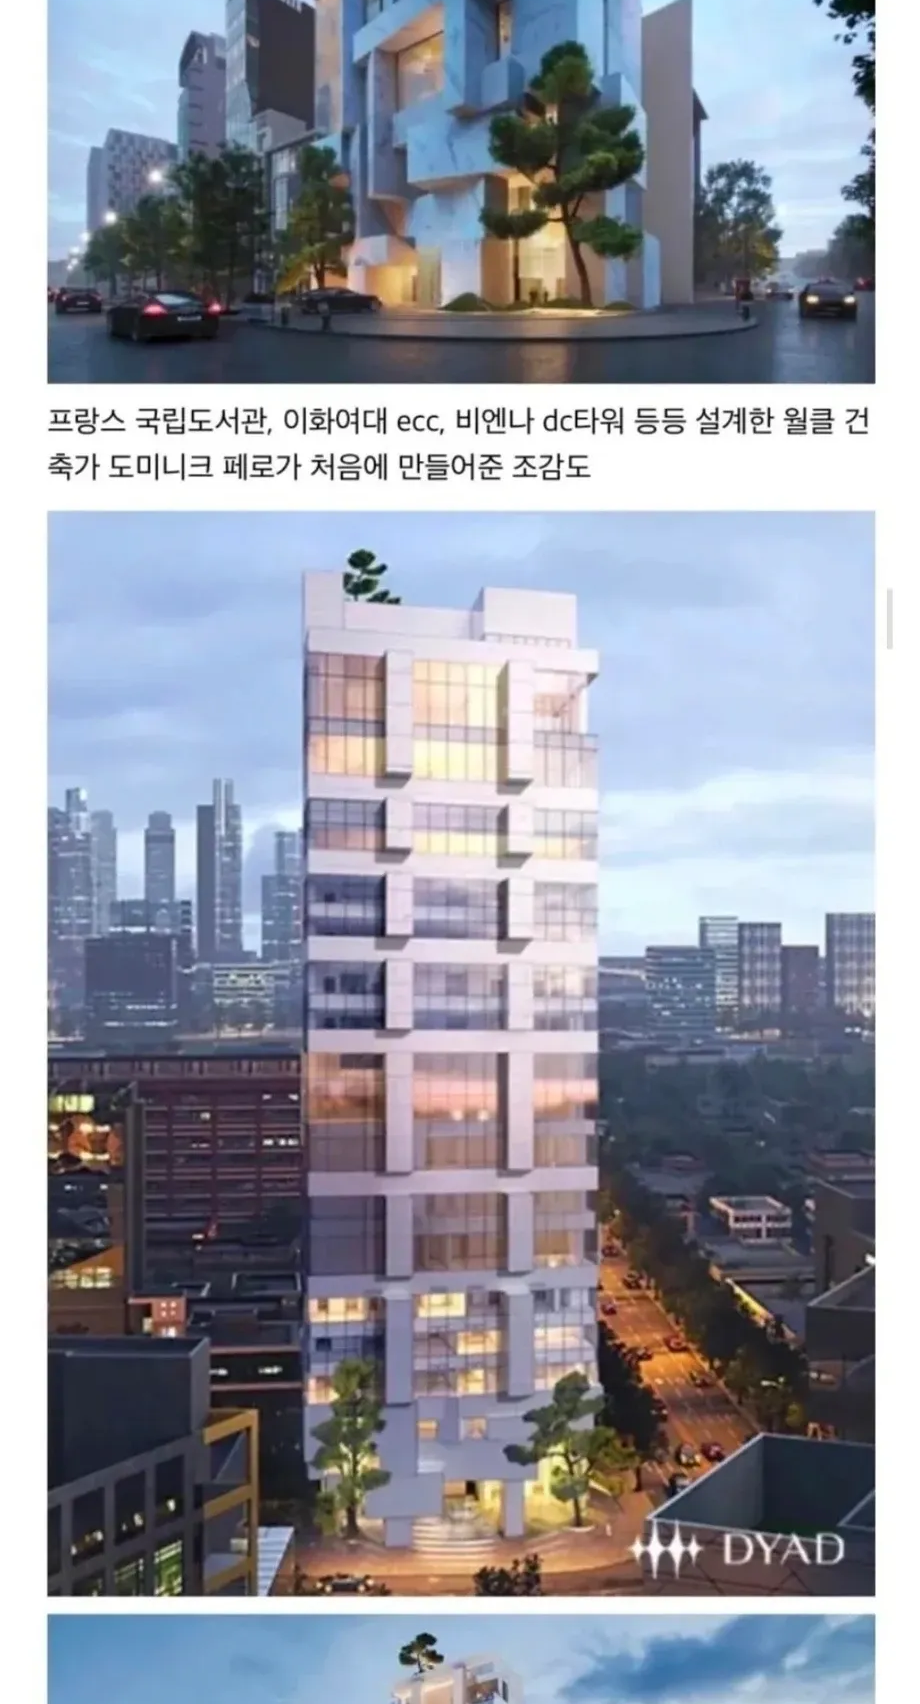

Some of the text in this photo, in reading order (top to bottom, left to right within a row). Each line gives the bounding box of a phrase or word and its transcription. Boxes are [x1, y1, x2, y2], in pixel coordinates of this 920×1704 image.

[47, 406, 869, 436] 프랑스 국립도서관, 이화여대 ecc, 비엔나 dc타워 등등 설계한 월클 건
[47, 452, 592, 482] 축가 도미니크 페로가 처음에 만들어준 조감도
